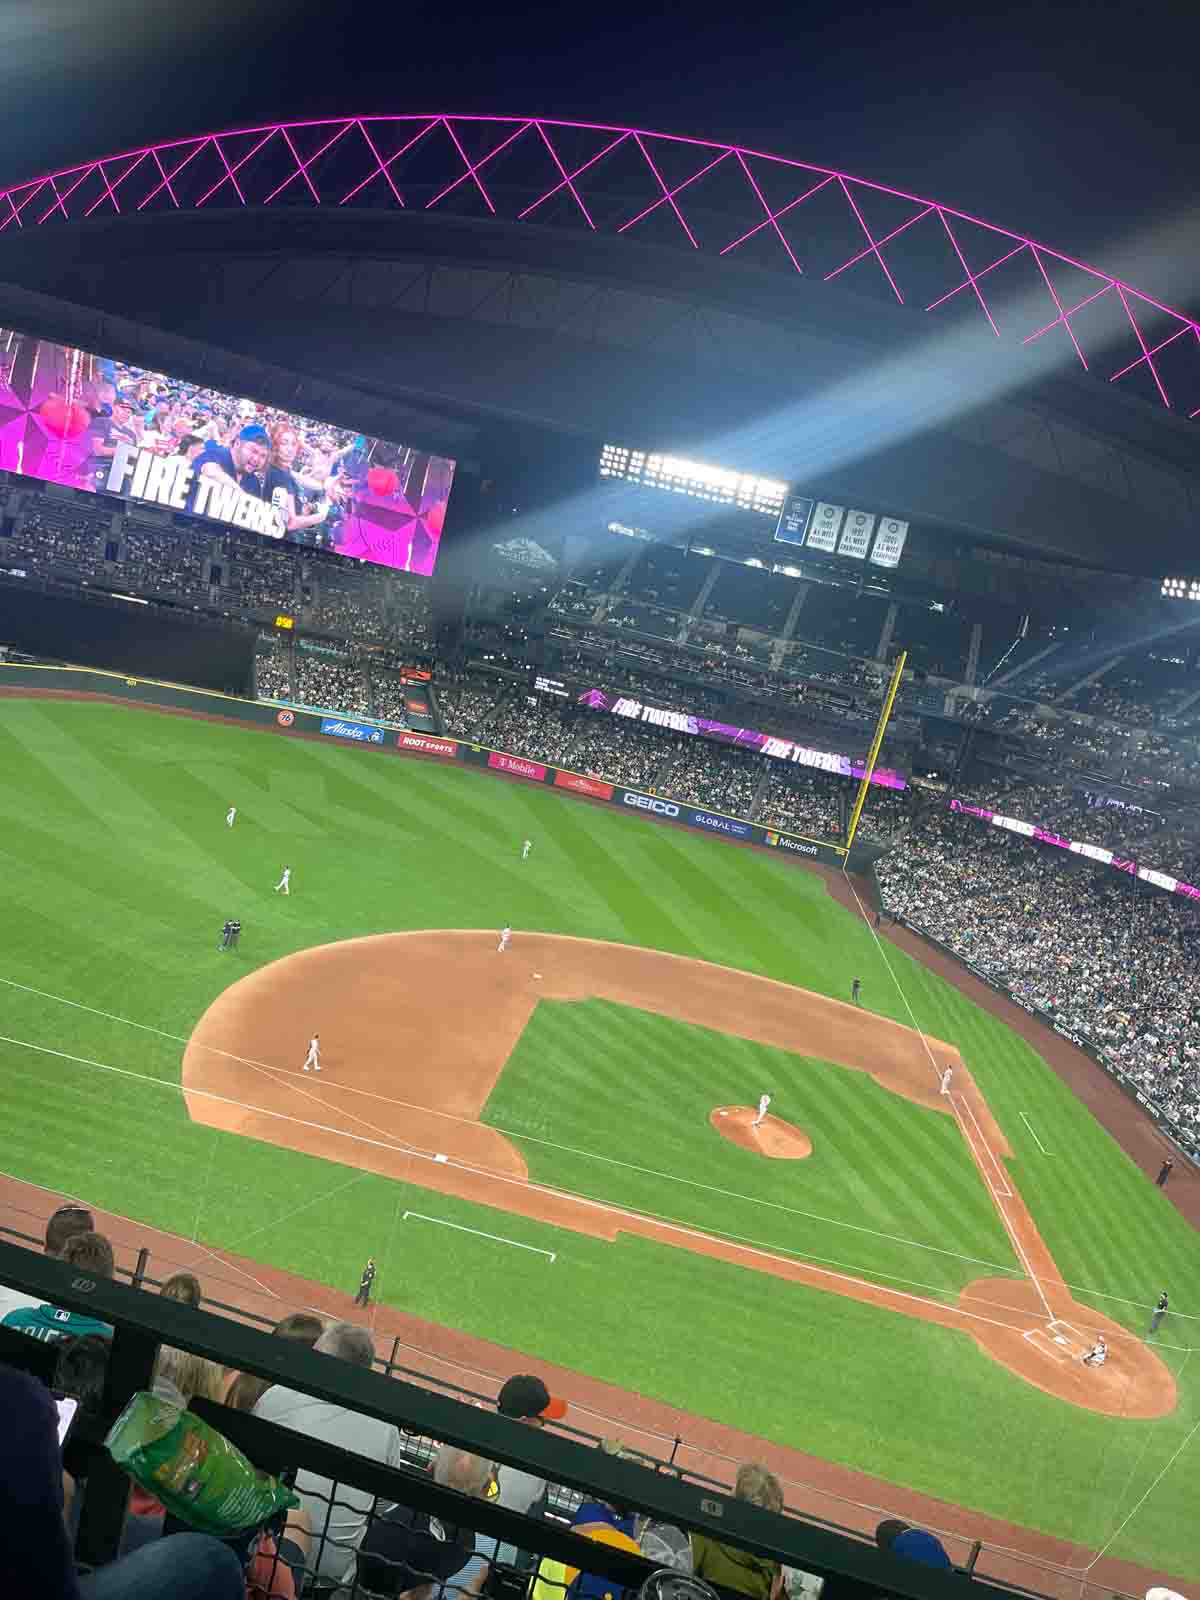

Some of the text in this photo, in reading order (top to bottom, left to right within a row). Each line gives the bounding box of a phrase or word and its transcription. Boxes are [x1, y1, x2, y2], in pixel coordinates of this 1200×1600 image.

[107, 441, 194, 509] FIRE
[325, 723, 363, 737] Alaska
[403, 737, 453, 753] ROOT SPORTS
[623, 792, 680, 817] GEICO
[695, 815, 730, 831] GLOBAL
[779, 837, 818, 855] Microsoft
